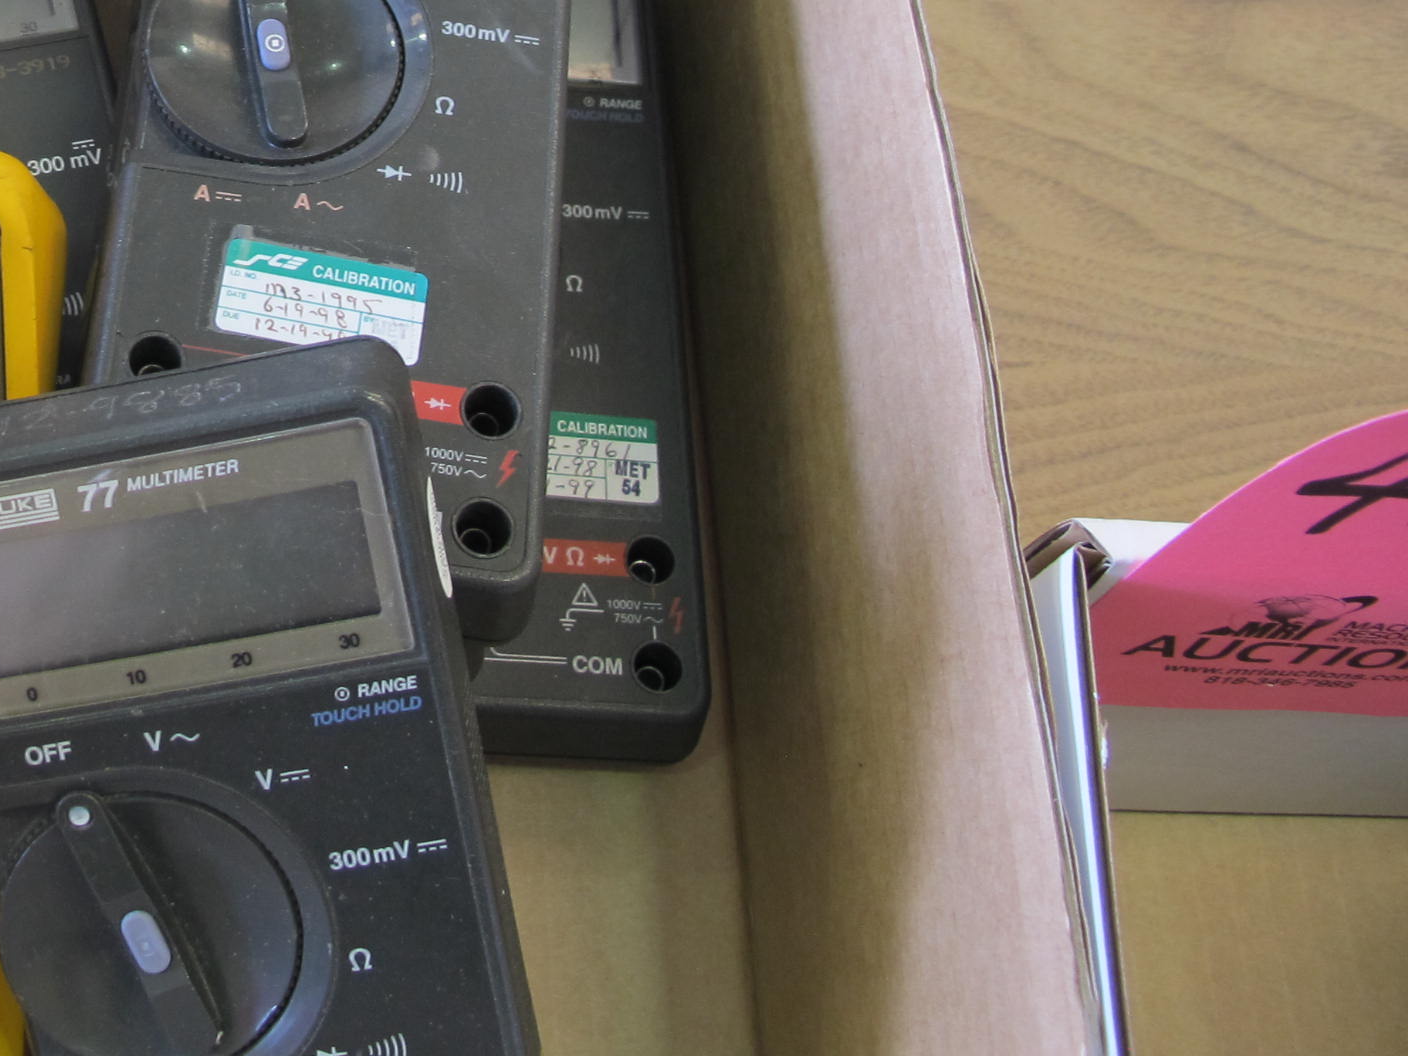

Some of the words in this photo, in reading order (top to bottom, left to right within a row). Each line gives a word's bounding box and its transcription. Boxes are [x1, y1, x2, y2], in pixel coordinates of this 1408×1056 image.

[20, 20, 39, 34] 30
[600, 97, 643, 111] RANGE
[27, 154, 65, 177] 300
[70, 148, 103, 170] mV
[312, 264, 416, 296] CALIBRATION
[557, 419, 648, 439] CALIBRATION
[425, 446, 464, 462] 1000V
[430, 461, 463, 477] 750V
[615, 459, 651, 480] MET
[77, 480, 118, 512] 77
[127, 458, 240, 493] MULTIMETER
[622, 479, 641, 497] 54
[607, 599, 641, 611] 1000V
[614, 613, 642, 624] 750V
[125, 668, 147, 685] 10
[230, 651, 253, 669] 20
[338, 632, 361, 650] 30
[572, 654, 623, 677] COM
[357, 675, 418, 698] RANGE
[311, 703, 371, 728] TOUCH
[373, 694, 423, 718] HOLD
[24, 741, 72, 766] OFF
